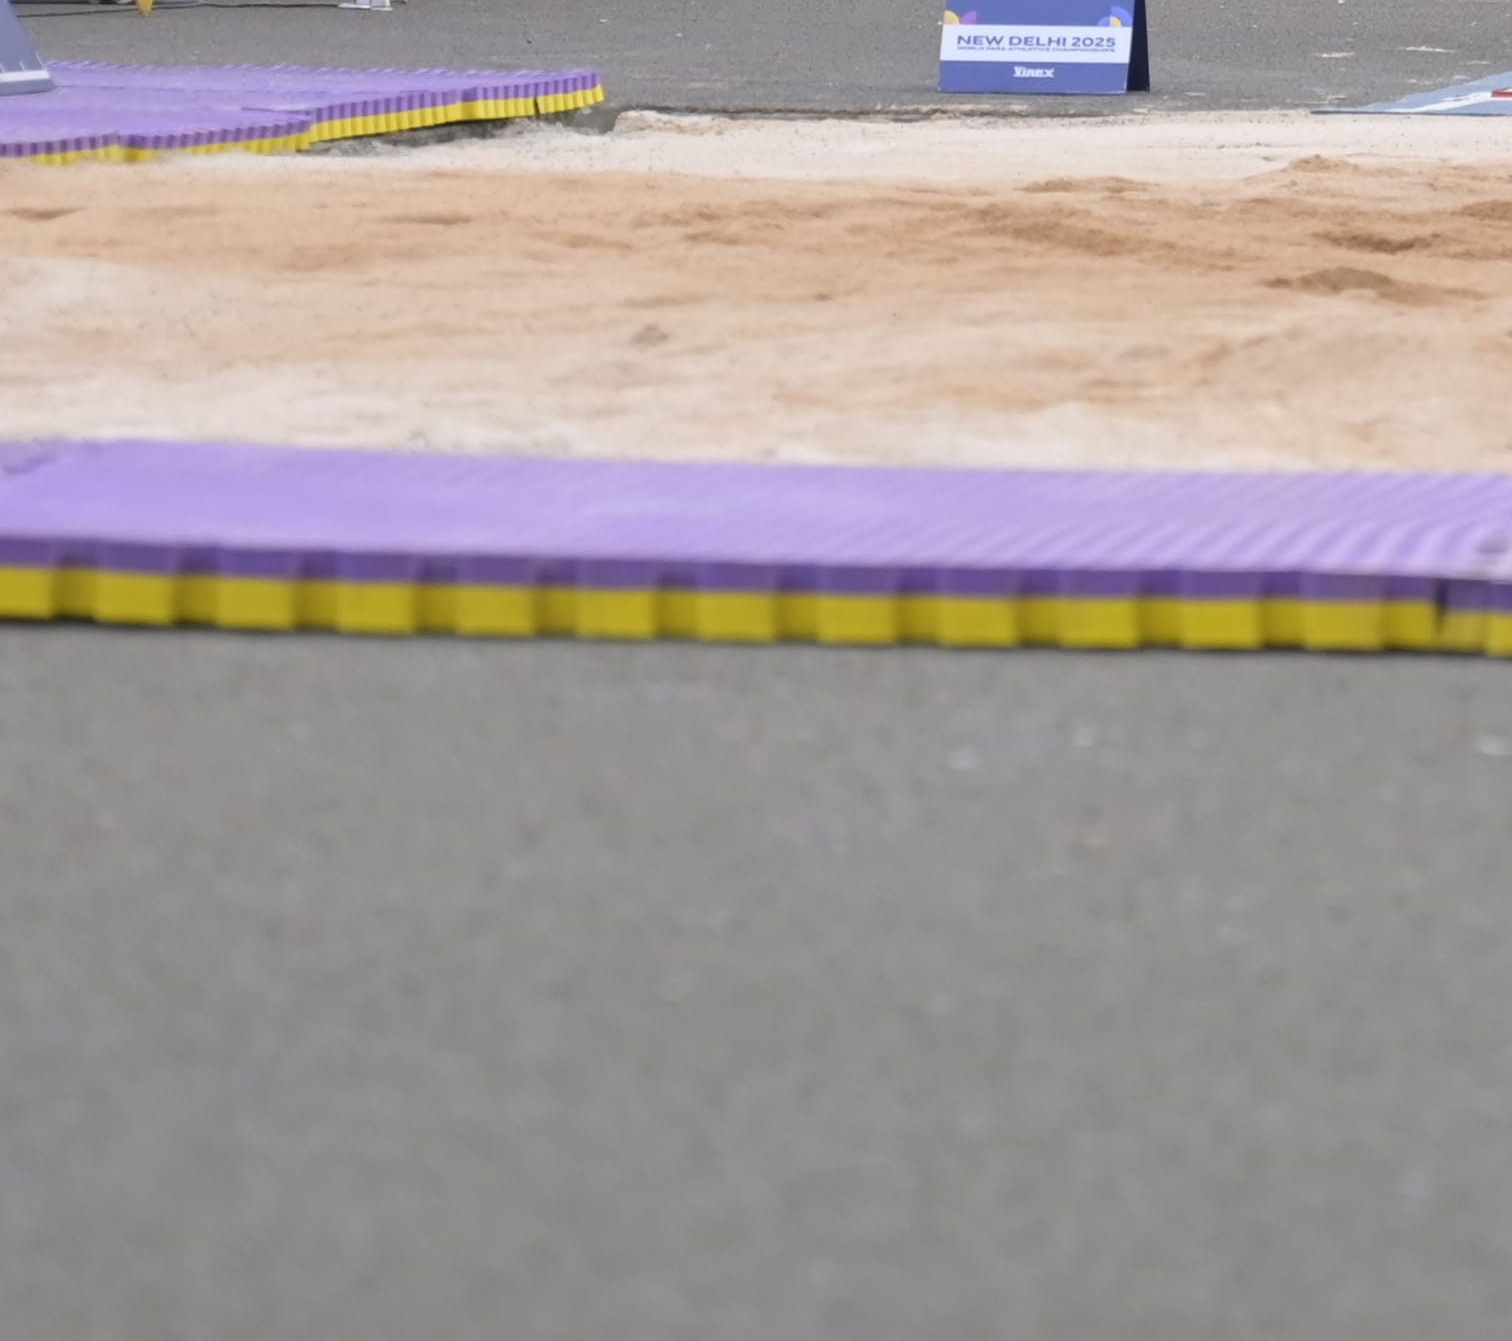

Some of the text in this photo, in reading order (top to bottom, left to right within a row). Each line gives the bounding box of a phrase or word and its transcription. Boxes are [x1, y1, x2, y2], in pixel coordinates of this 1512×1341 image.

[956, 35, 1116, 48] NEW DELHI 2025
[1013, 66, 1055, 78] Vinex
